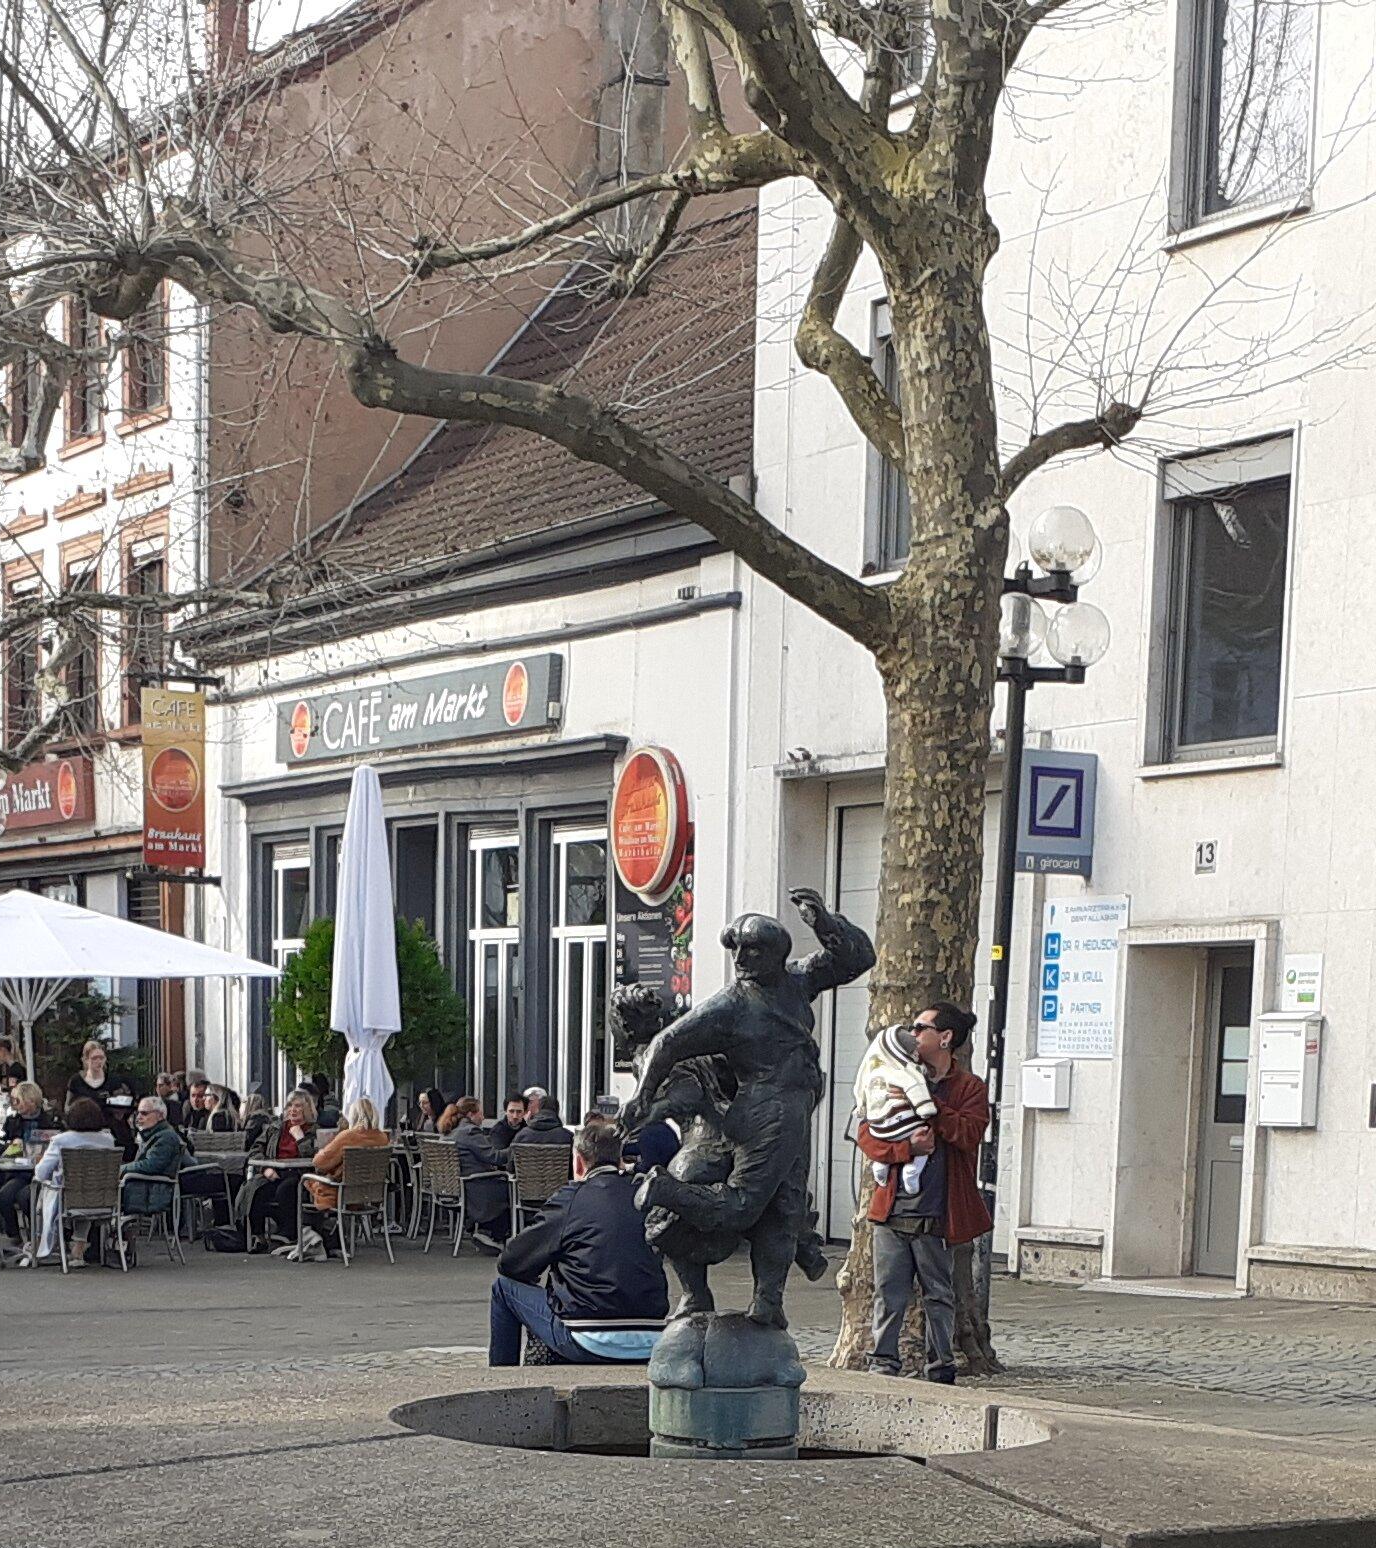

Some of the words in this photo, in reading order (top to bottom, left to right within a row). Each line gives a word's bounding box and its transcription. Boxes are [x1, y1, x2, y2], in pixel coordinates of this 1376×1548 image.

[322, 691, 383, 750] CAFÉ
[388, 701, 418, 732] am
[422, 683, 489, 726] Markt
[11, 778, 52, 813] Markt
[147, 827, 202, 842] Brauhaus
[147, 842, 165, 851] am
[168, 841, 203, 853] Markt
[1196, 842, 1215, 865] 13
[1040, 856, 1080, 871] girocard
[1047, 937, 1059, 955] H
[1045, 968, 1057, 986] K
[1044, 999, 1056, 1017] P
[1070, 1002, 1102, 1013] PARTNER
